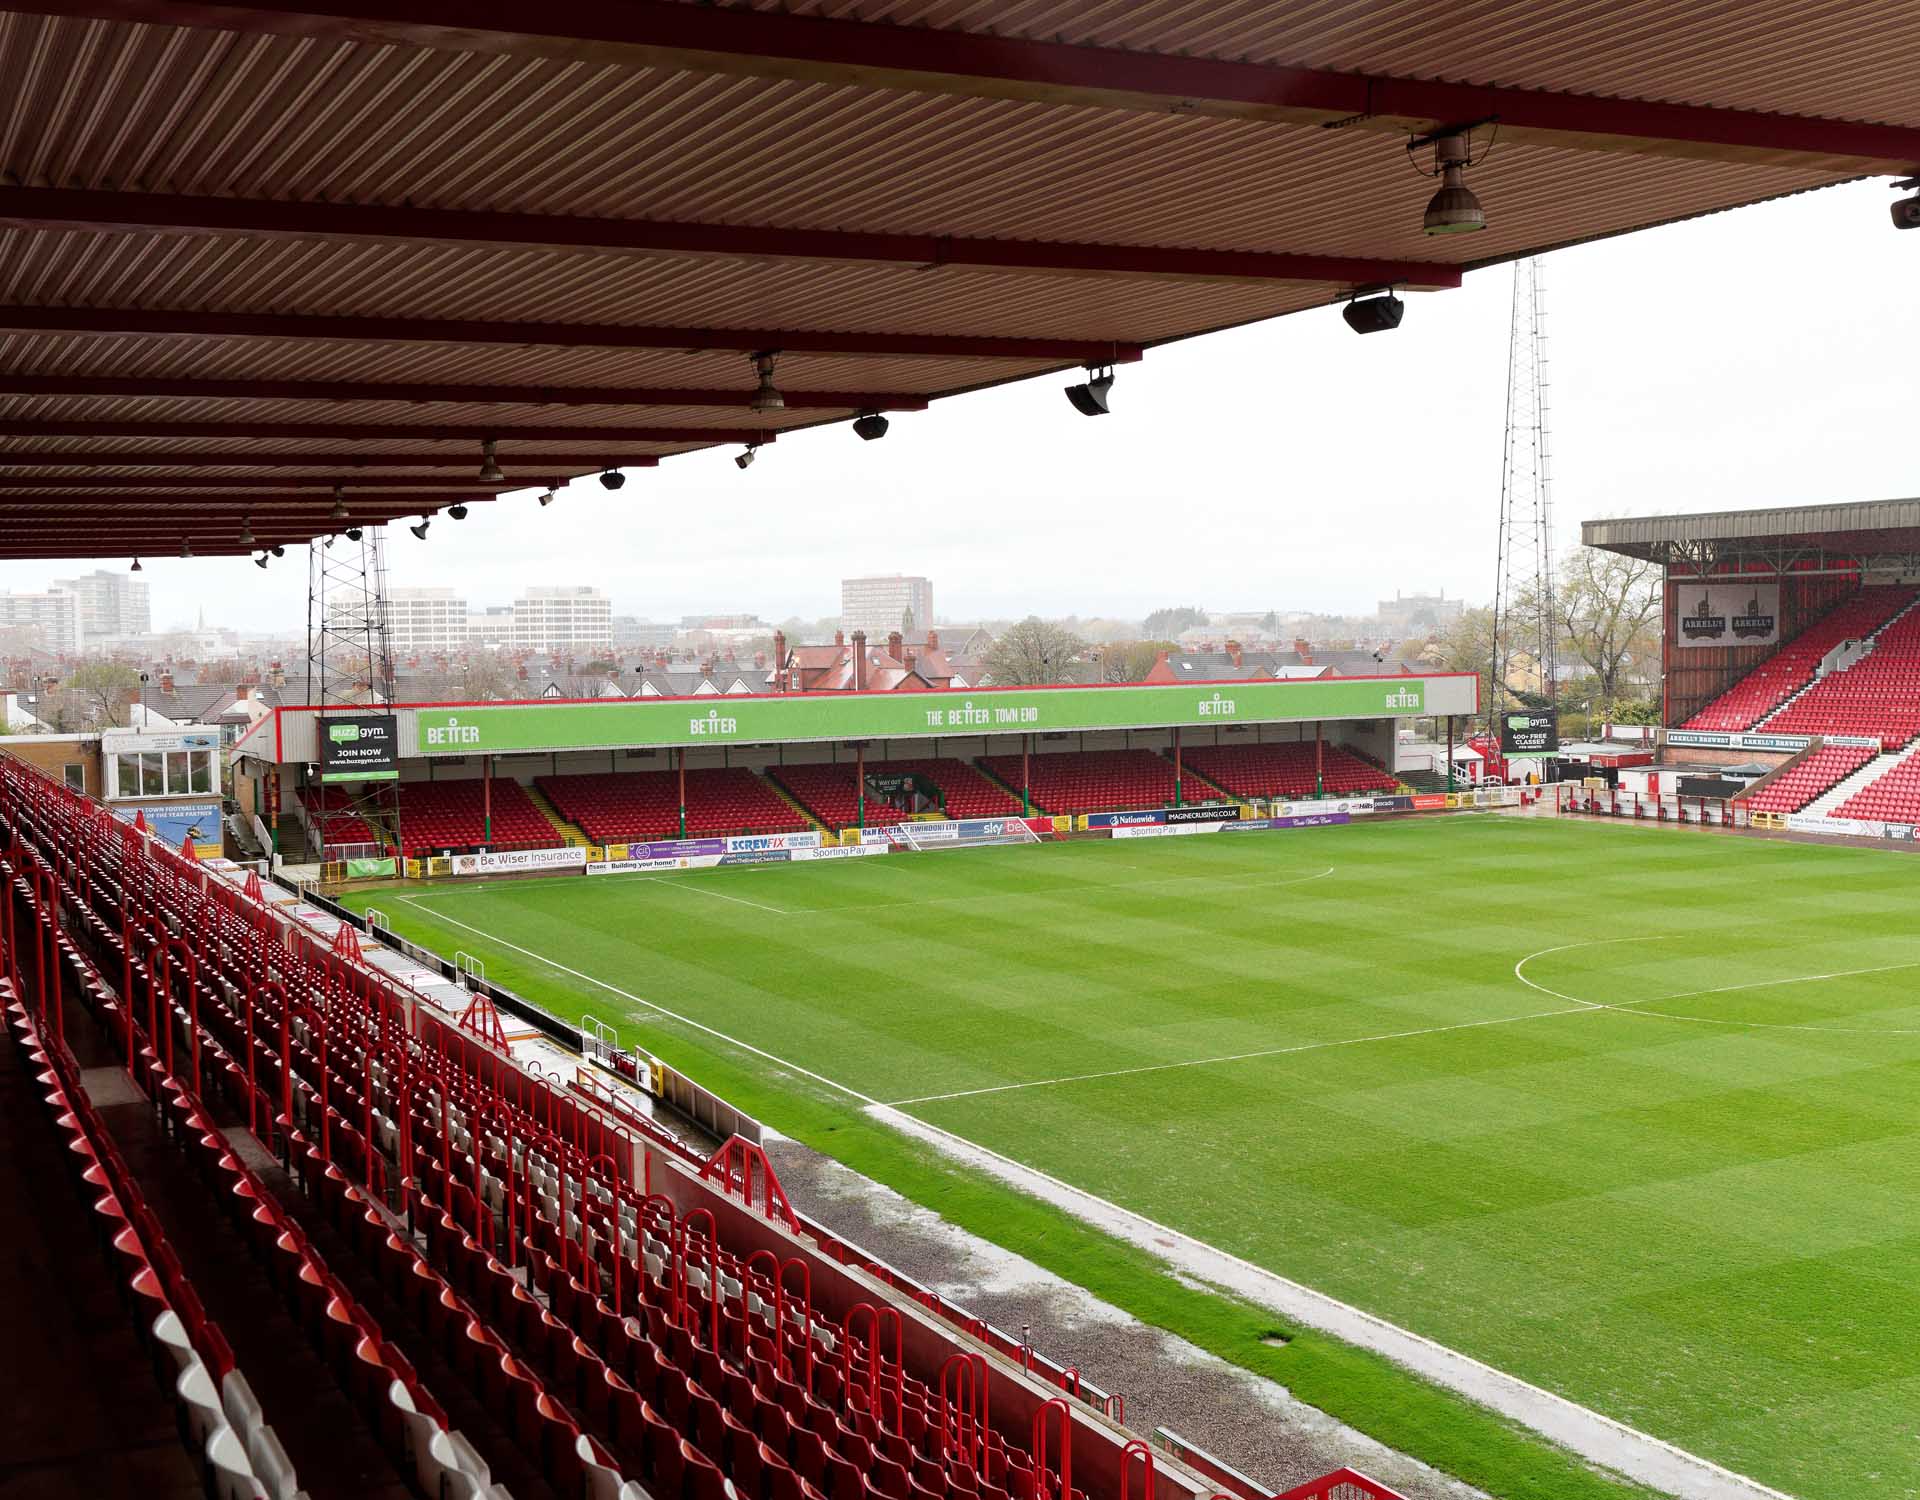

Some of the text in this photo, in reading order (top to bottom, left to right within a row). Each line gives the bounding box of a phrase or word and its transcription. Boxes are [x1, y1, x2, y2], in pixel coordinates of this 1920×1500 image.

[1199, 696, 1236, 715] BETTER
[1385, 690, 1419, 708] BETTER
[926, 704, 1038, 726] THE BETTER TOWN END
[689, 713, 737, 735] BETTER
[1529, 717, 1548, 727] gym
[360, 727, 384, 738] gym
[427, 722, 480, 744] BETTER
[337, 748, 382, 757] JOIN NOW
[328, 757, 391, 765] www.buzzgym.co.uk
[1119, 814, 1156, 825] Nationwide
[1168, 809, 1238, 820] IMAGINECRUISING.CO.UK
[983, 822, 1004, 835] sky
[1130, 825, 1177, 837] Sporting Pay
[731, 837, 786, 851] SCREWFIX
[480, 850, 582, 866] Be Wiser Insurance
[812, 845, 866, 859] Sporting Pay
[611, 861, 637, 870] Building
[638, 861, 653, 869] your
[654, 858, 677, 867] home?
